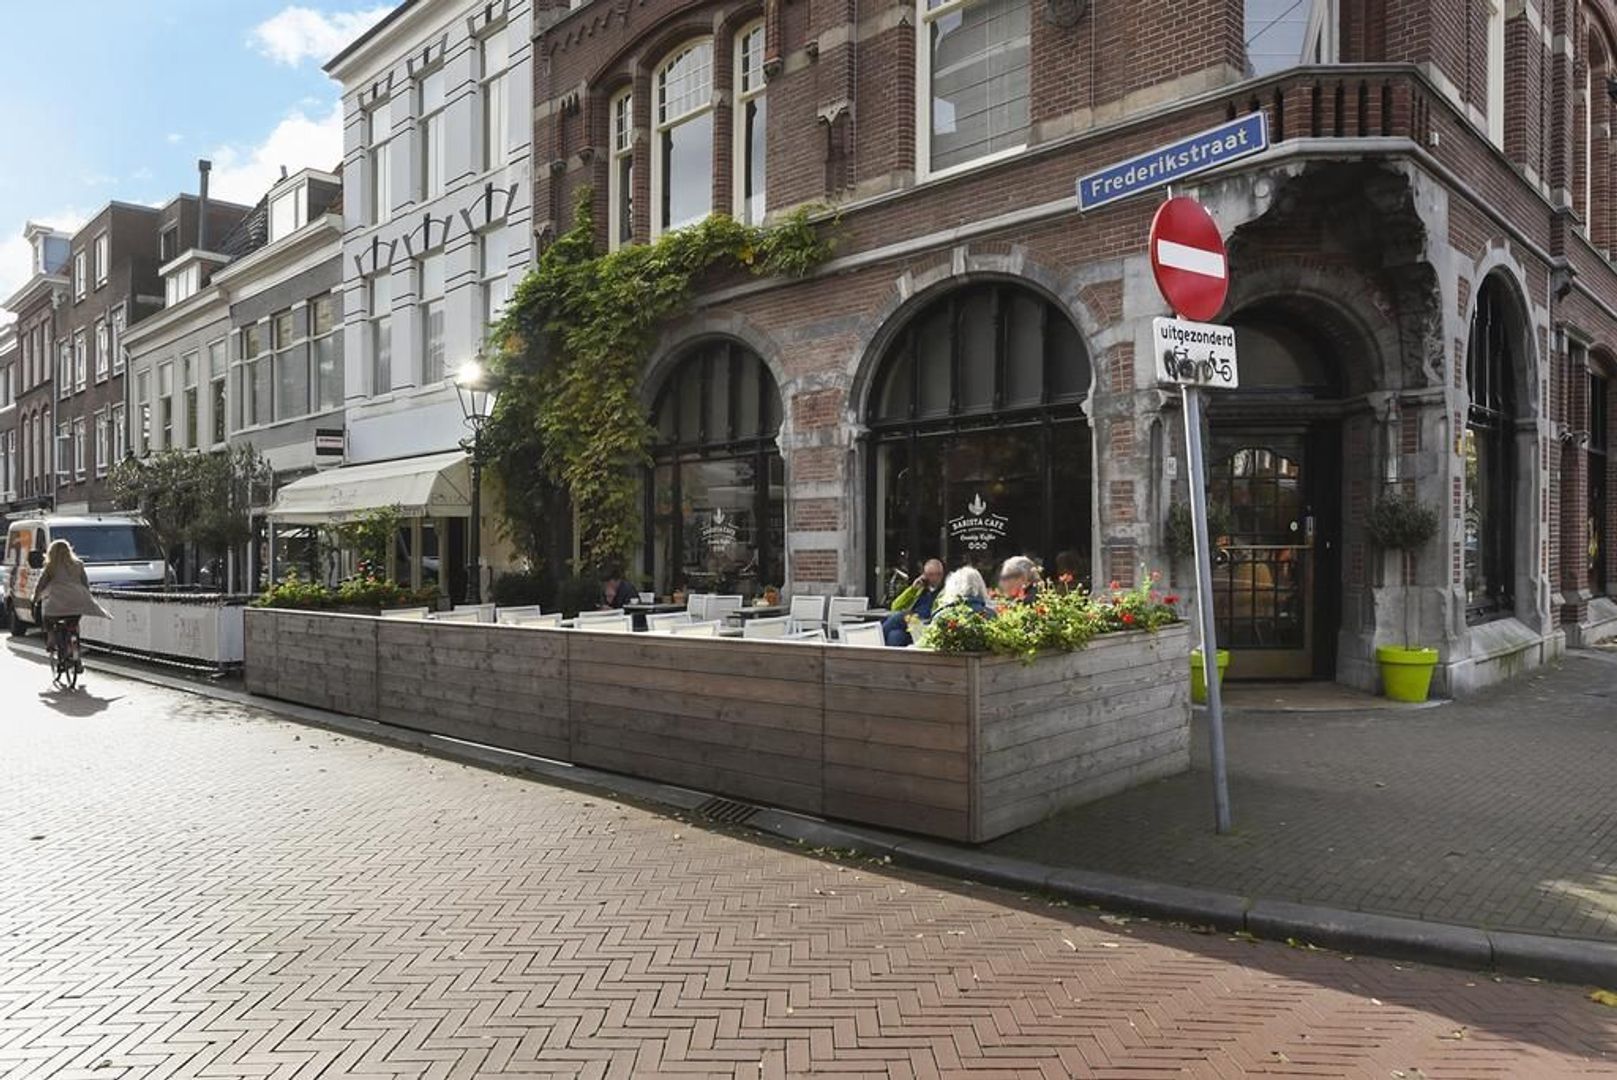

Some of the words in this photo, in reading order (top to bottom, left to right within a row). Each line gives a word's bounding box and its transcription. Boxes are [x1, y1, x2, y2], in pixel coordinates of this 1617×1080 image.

[1091, 128, 1248, 197] Frederikstraat
[1160, 325, 1233, 347] uitgezonderd
[952, 518, 983, 530] BARISTA
